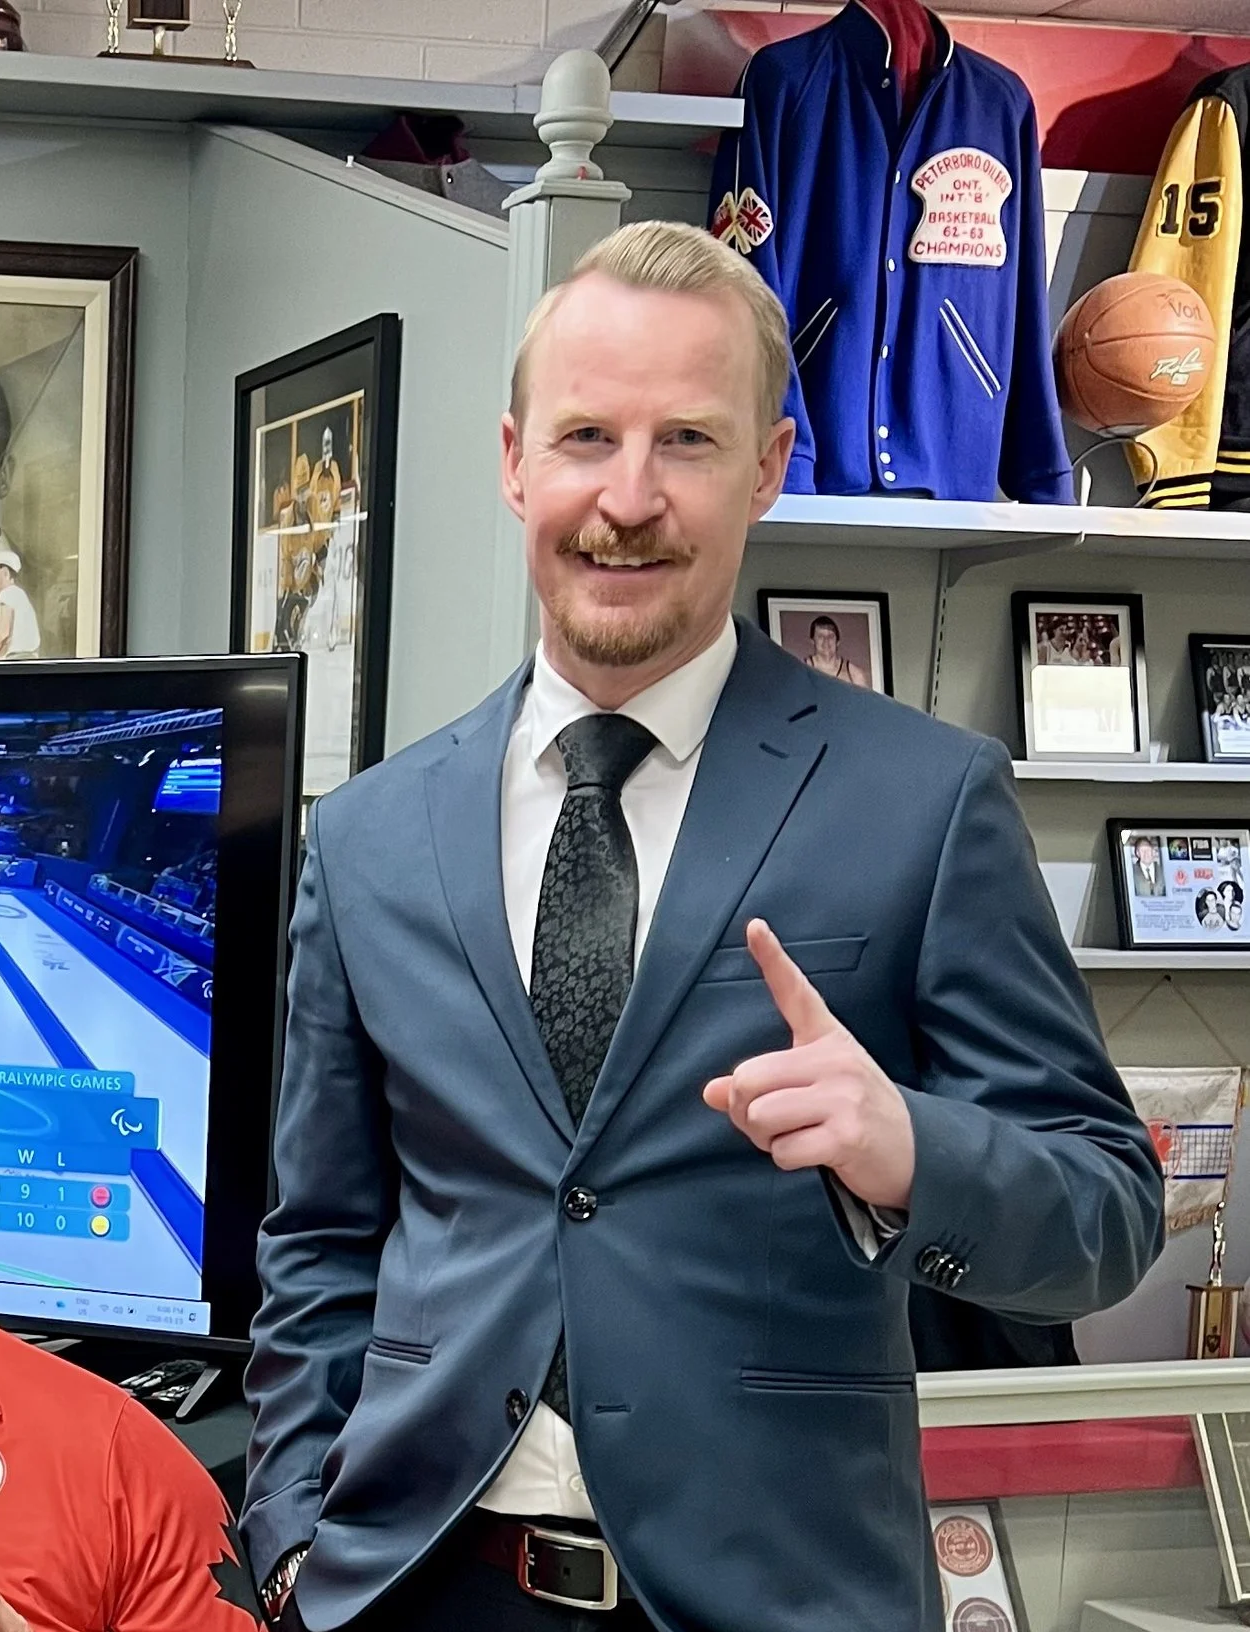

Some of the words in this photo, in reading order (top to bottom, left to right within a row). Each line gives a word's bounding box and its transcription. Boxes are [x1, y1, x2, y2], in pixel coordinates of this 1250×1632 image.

[915, 152, 982, 191] PETERBORO
[1157, 177, 1225, 238] 15
[928, 211, 997, 225] BASKETBALL
[943, 226, 984, 239] 62-63
[914, 241, 1003, 258] CHAMPIONS
[70, 1073, 121, 1091] GAMES
[17, 1149, 34, 1164] W
[57, 1151, 66, 1167] L
[20, 1183, 31, 1199] 9
[58, 1186, 65, 1202] 1
[17, 1212, 35, 1228] 10
[56, 1214, 66, 1231] 0
